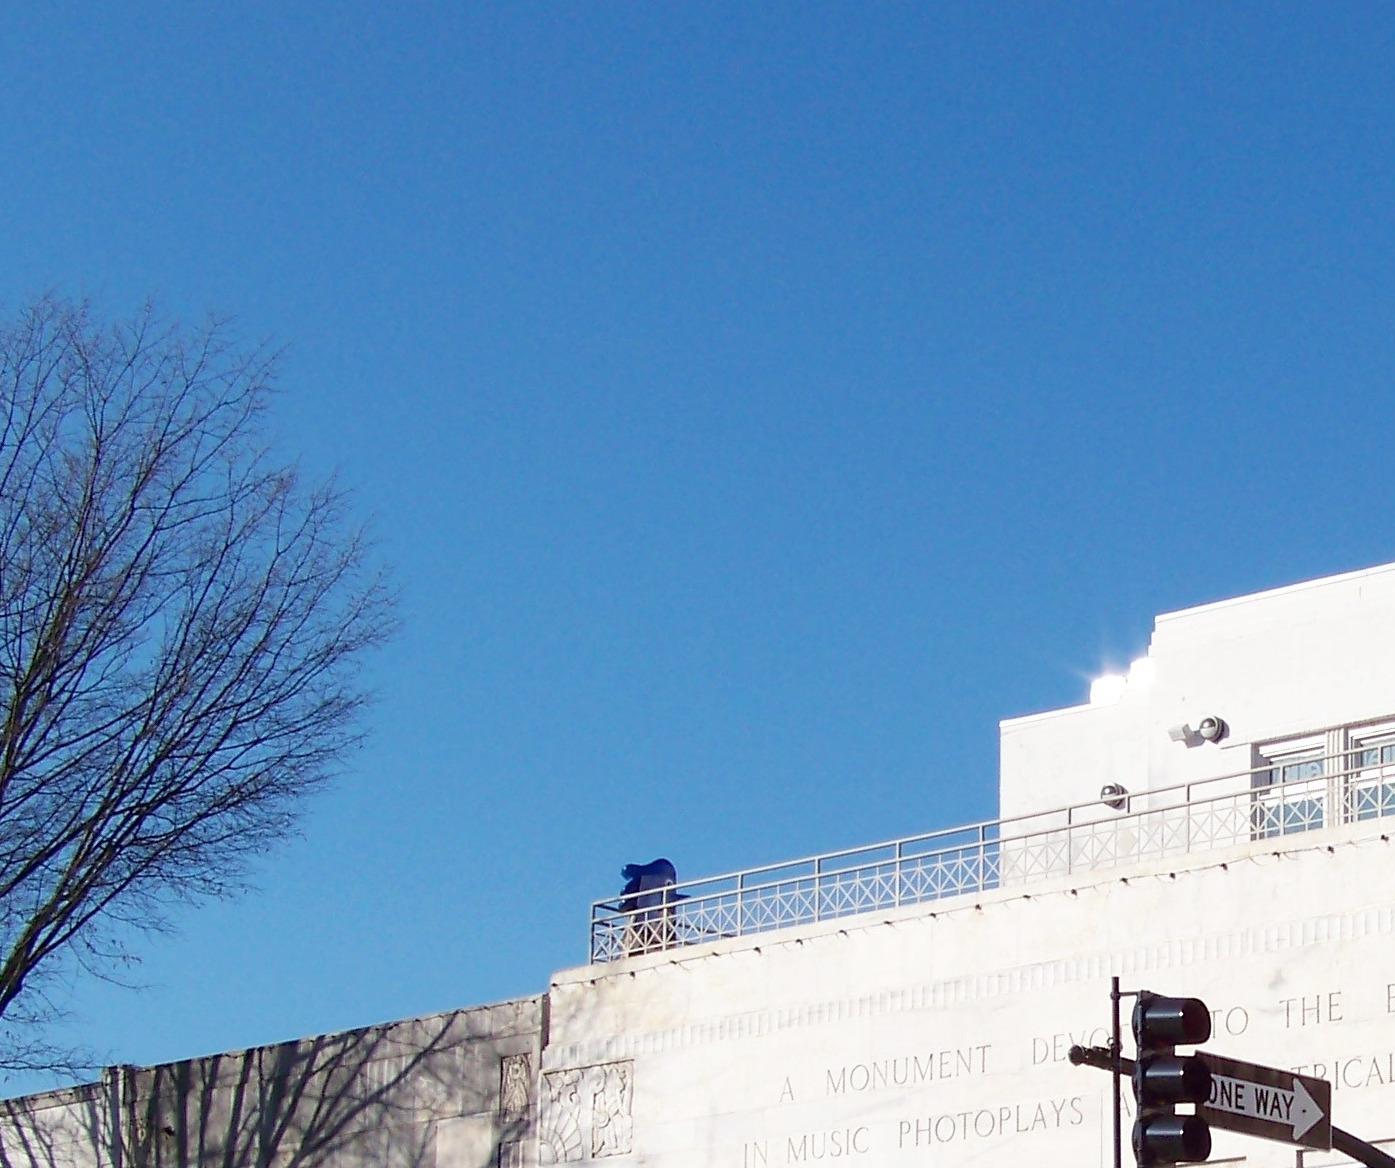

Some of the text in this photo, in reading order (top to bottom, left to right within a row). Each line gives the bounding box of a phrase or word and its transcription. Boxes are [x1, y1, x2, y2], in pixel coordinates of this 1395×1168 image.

[779, 1077, 795, 1103] A
[826, 1044, 992, 1097] MONUMENT
[1279, 991, 1343, 1029] THE
[787, 1126, 870, 1164] MUSIC
[898, 1096, 1084, 1149] PHOTOPLAYS
[1255, 1087, 1295, 1121] WAY
